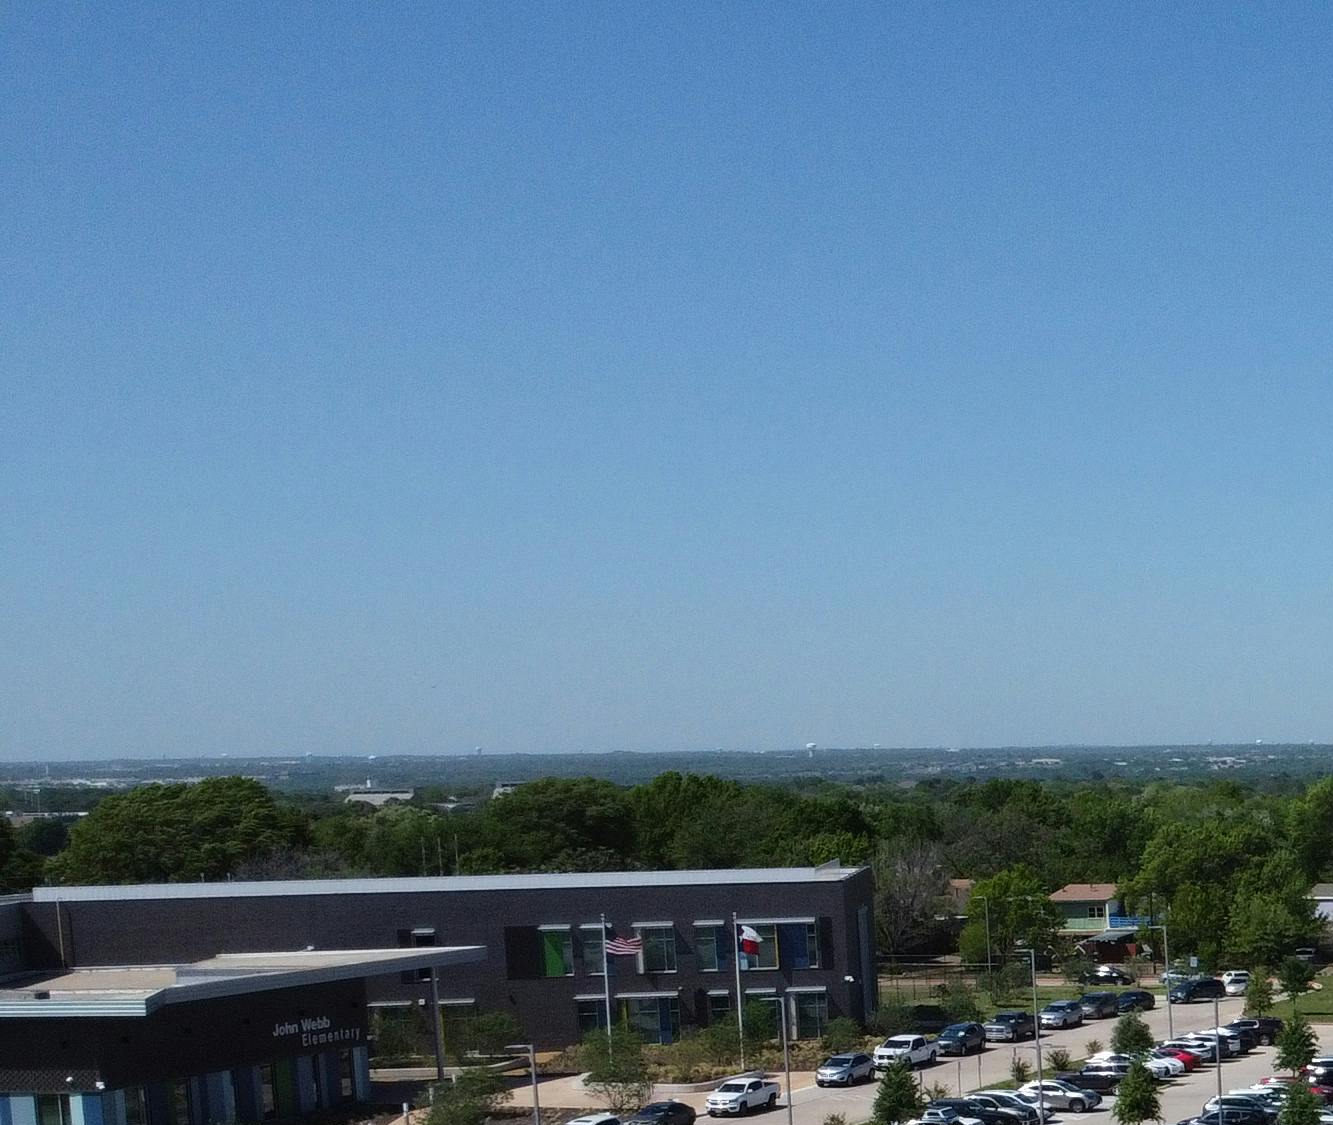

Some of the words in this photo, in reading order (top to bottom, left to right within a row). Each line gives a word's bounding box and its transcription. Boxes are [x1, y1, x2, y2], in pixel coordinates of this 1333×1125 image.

[272, 1022, 299, 1037] John
[300, 1016, 331, 1032] Webb
[301, 1027, 360, 1047] Elementary
